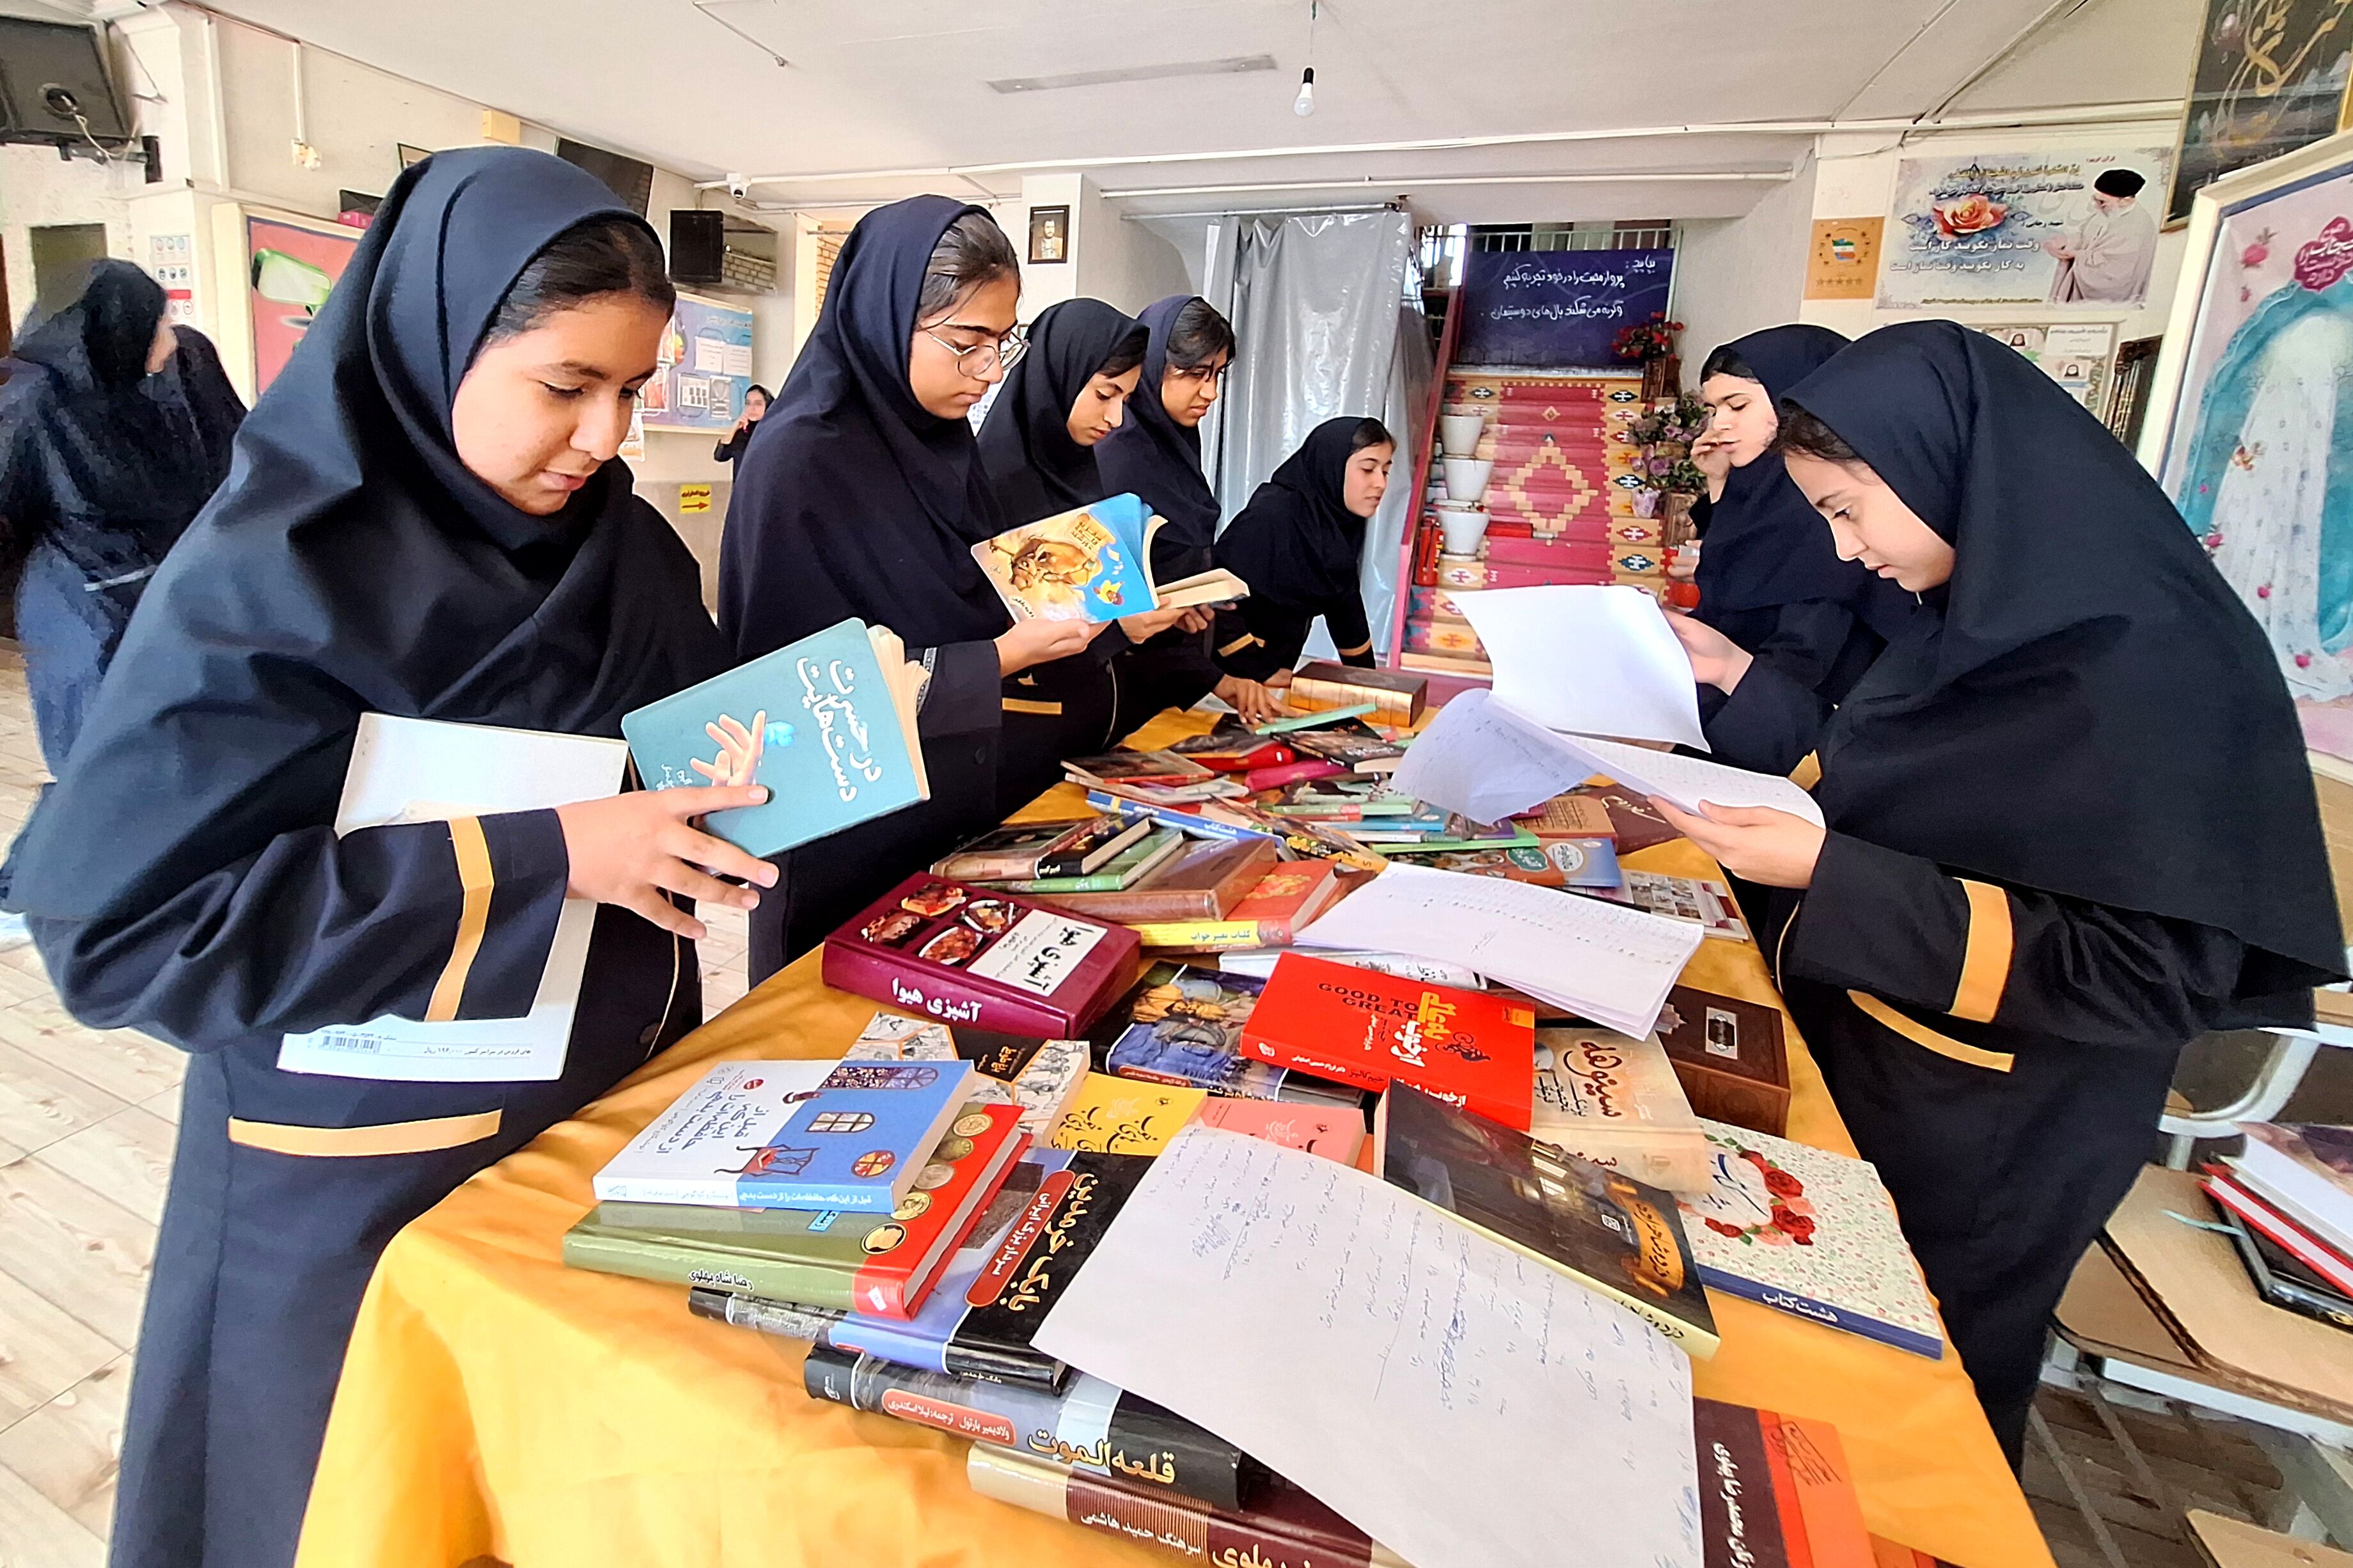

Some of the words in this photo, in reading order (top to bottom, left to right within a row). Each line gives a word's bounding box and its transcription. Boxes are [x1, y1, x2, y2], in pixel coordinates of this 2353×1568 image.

[1908, 240, 1933, 251] است
[1935, 240, 1952, 253] کار
[1992, 240, 2013, 252] نماز
[2016, 239, 2040, 252] وقت
[1889, 260, 1912, 271] است
[1914, 262, 1933, 273] نماز
[1935, 261, 1958, 273] وقت
[1994, 260, 2012, 272] کار
[2015, 262, 2025, 270] به
[1503, 263, 1531, 290] کنیم
[850, 751, 883, 781] در
[892, 976, 924, 1005] هیوا
[1318, 982, 1381, 1003] GOOD
[1390, 997, 1420, 1012] TO
[926, 998, 983, 1023] آشپزی
[1341, 996, 1419, 1021] GREAT
[668, 1113, 704, 1144] دست
[734, 1117, 757, 1138] قبل
[856, 1195, 872, 1205] قبل
[991, 1244, 1019, 1276] سردار
[1010, 1221, 1035, 1245] بزرگ
[1028, 1193, 1052, 1221] ایرانی
[999, 1255, 1054, 1311] بابک
[1043, 1173, 1099, 1255] خرمدین
[688, 1267, 716, 1287] پهلوی
[715, 1268, 733, 1285] شاه
[734, 1272, 755, 1291] رضا
[1762, 1292, 1798, 1309] کتاب
[1795, 1301, 1839, 1322] هشت
[886, 1400, 918, 1415] اسکندری
[929, 1408, 955, 1426] ترجمه:
[959, 1415, 981, 1435] بارتول
[981, 1424, 1011, 1441] ولادیمیر
[1027, 1428, 1112, 1468] الموت
[1112, 1448, 1176, 1485] قلعه
[1080, 1510, 1121, 1530] هاشمی
[1122, 1521, 1156, 1539] حمید
[1156, 1531, 1202, 1556] سرهنگ
